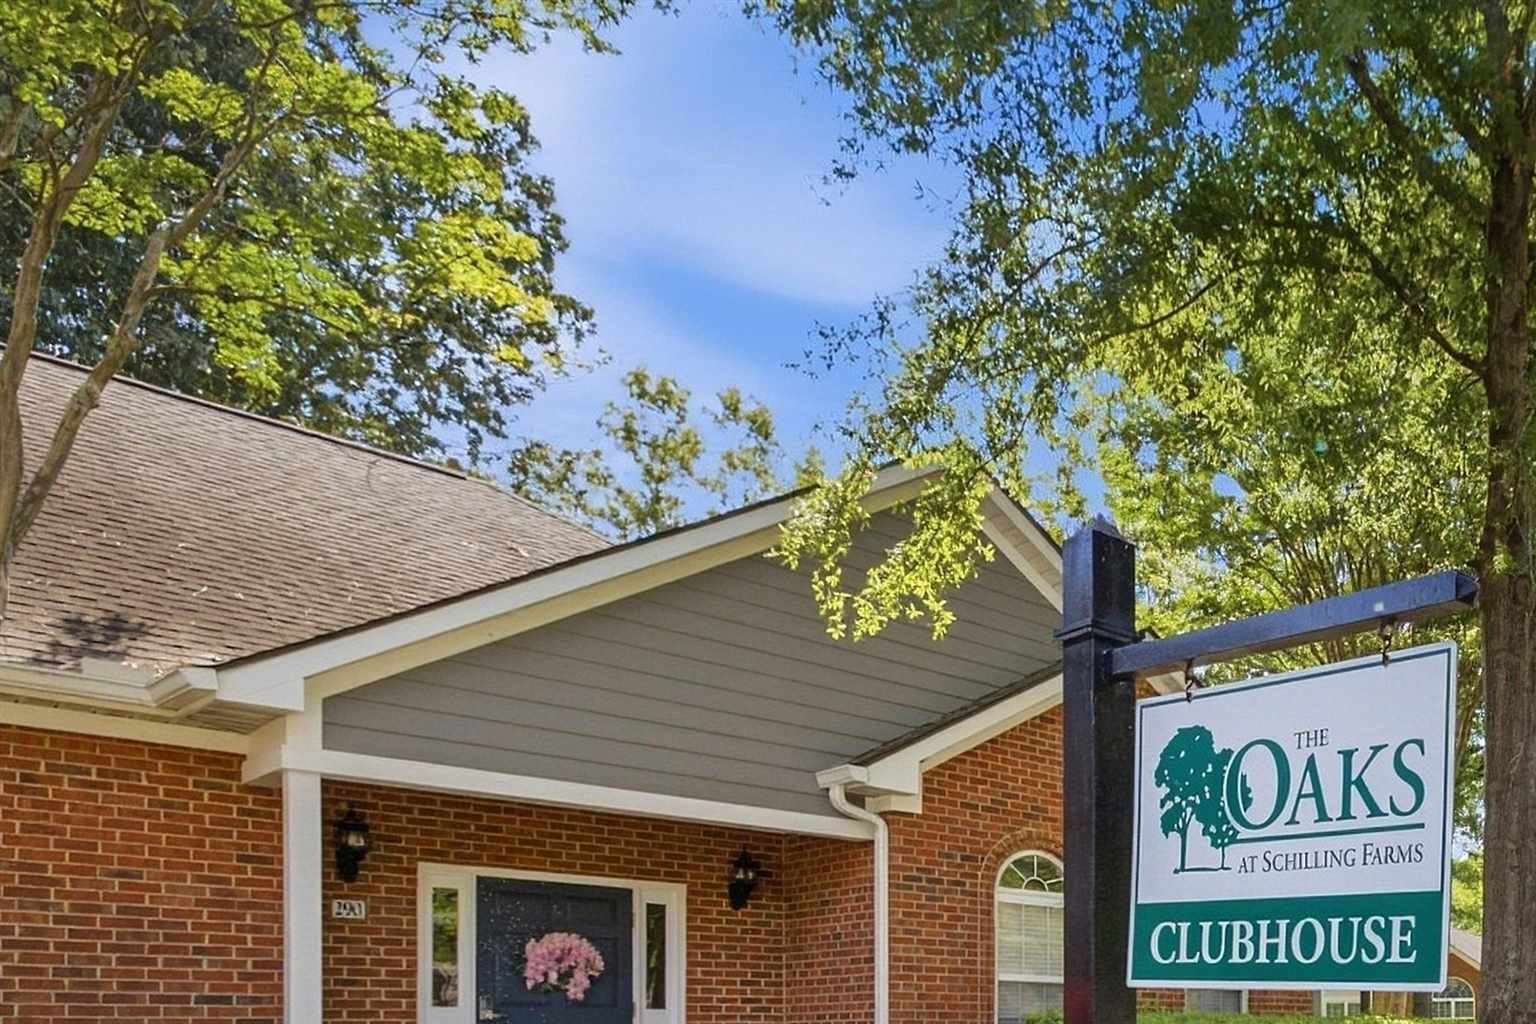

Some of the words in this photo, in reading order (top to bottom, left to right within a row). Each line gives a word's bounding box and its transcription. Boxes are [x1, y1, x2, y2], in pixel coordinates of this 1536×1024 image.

[1294, 728, 1329, 750] THE
[1226, 738, 1426, 831] OAKS
[1238, 855, 1258, 874] AT
[1262, 849, 1356, 873] SCHILLING
[1361, 842, 1425, 867] FARMS
[1150, 914, 1418, 965] CLUBHOUSE
